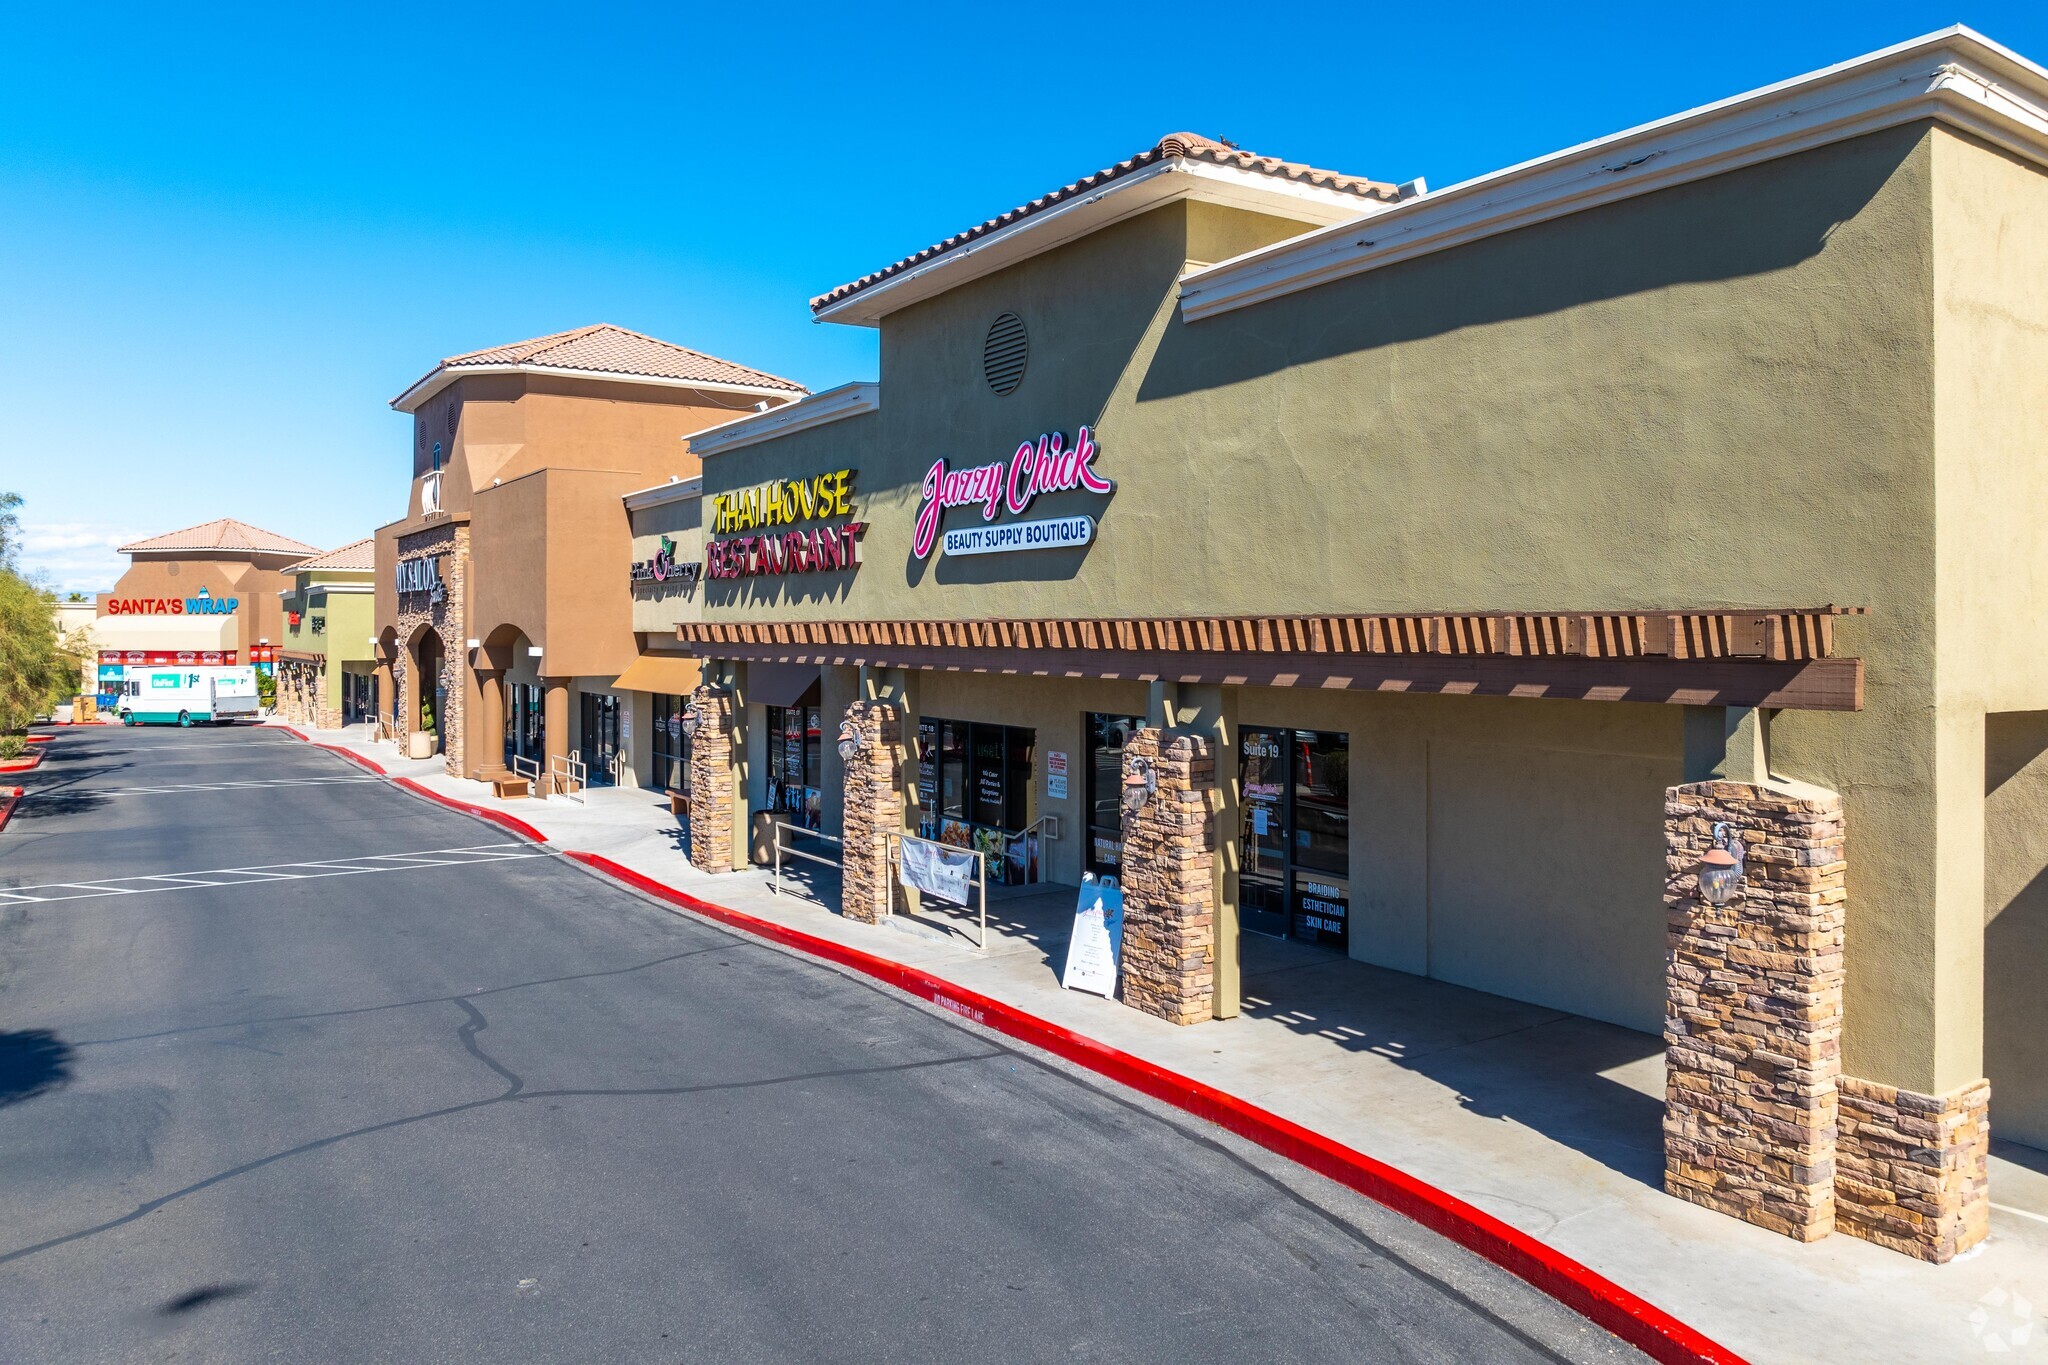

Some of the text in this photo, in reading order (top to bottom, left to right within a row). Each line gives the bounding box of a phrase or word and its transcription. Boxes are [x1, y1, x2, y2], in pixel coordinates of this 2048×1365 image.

[713, 468, 851, 534] THAI HOUSE
[914, 425, 1111, 559] Jazzy Chick
[947, 521, 1086, 551] BEAUTY SUPPLY BOUTIQUE
[706, 522, 864, 580] RESTAURANT
[630, 547, 699, 582] Pink Cherry
[408, 557, 436, 592] SALON
[108, 598, 239, 615] SANTA'S WRAP
[188, 673, 201, 689] 1st
[1243, 741, 1279, 758] Suite 19
[1094, 837, 1115, 850] NATURAL
[1103, 853, 1117, 865] CARE
[1308, 882, 1340, 899] BRAIDING
[1303, 897, 1345, 918] ESTHETICIAN
[1306, 915, 1342, 934] SKIN CARE
[941, 995, 960, 1013] PARKING
